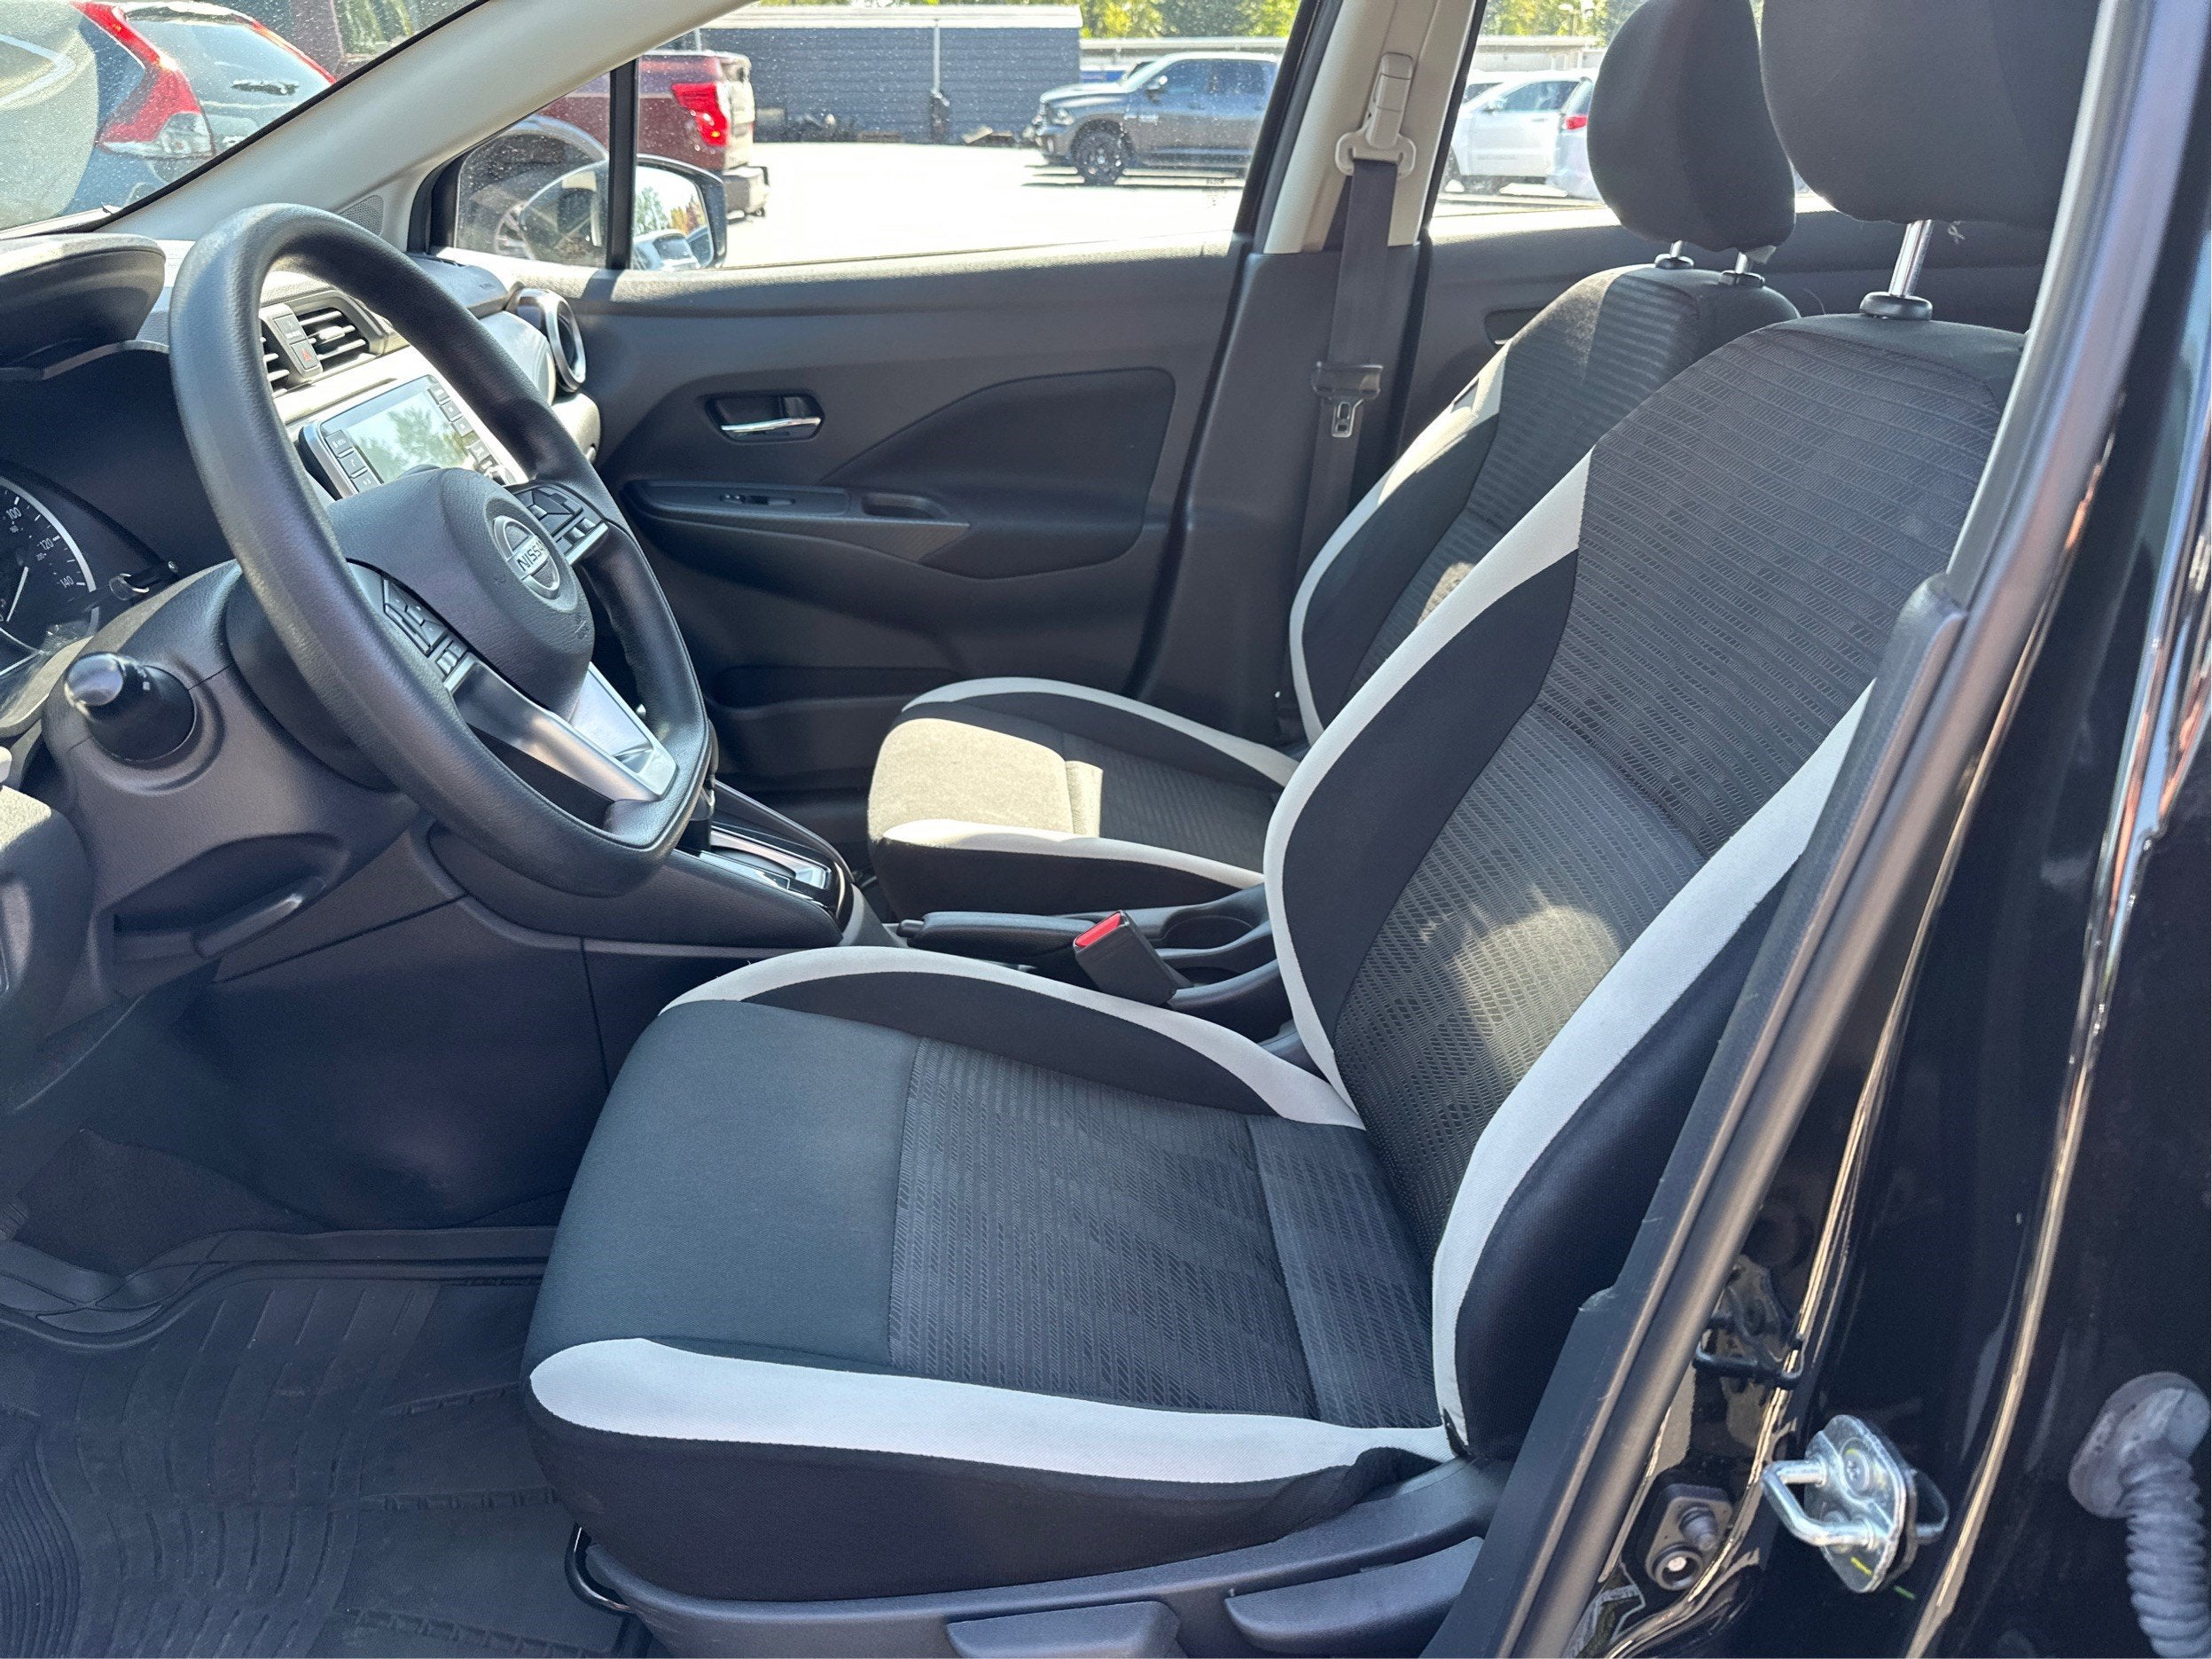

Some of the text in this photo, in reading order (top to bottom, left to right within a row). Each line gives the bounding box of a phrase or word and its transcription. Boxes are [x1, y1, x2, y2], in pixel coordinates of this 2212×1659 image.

[6, 506, 22, 520] 100
[40, 537, 54, 550] 120
[516, 540, 544, 572] NISS
[59, 575, 74, 588] 140
